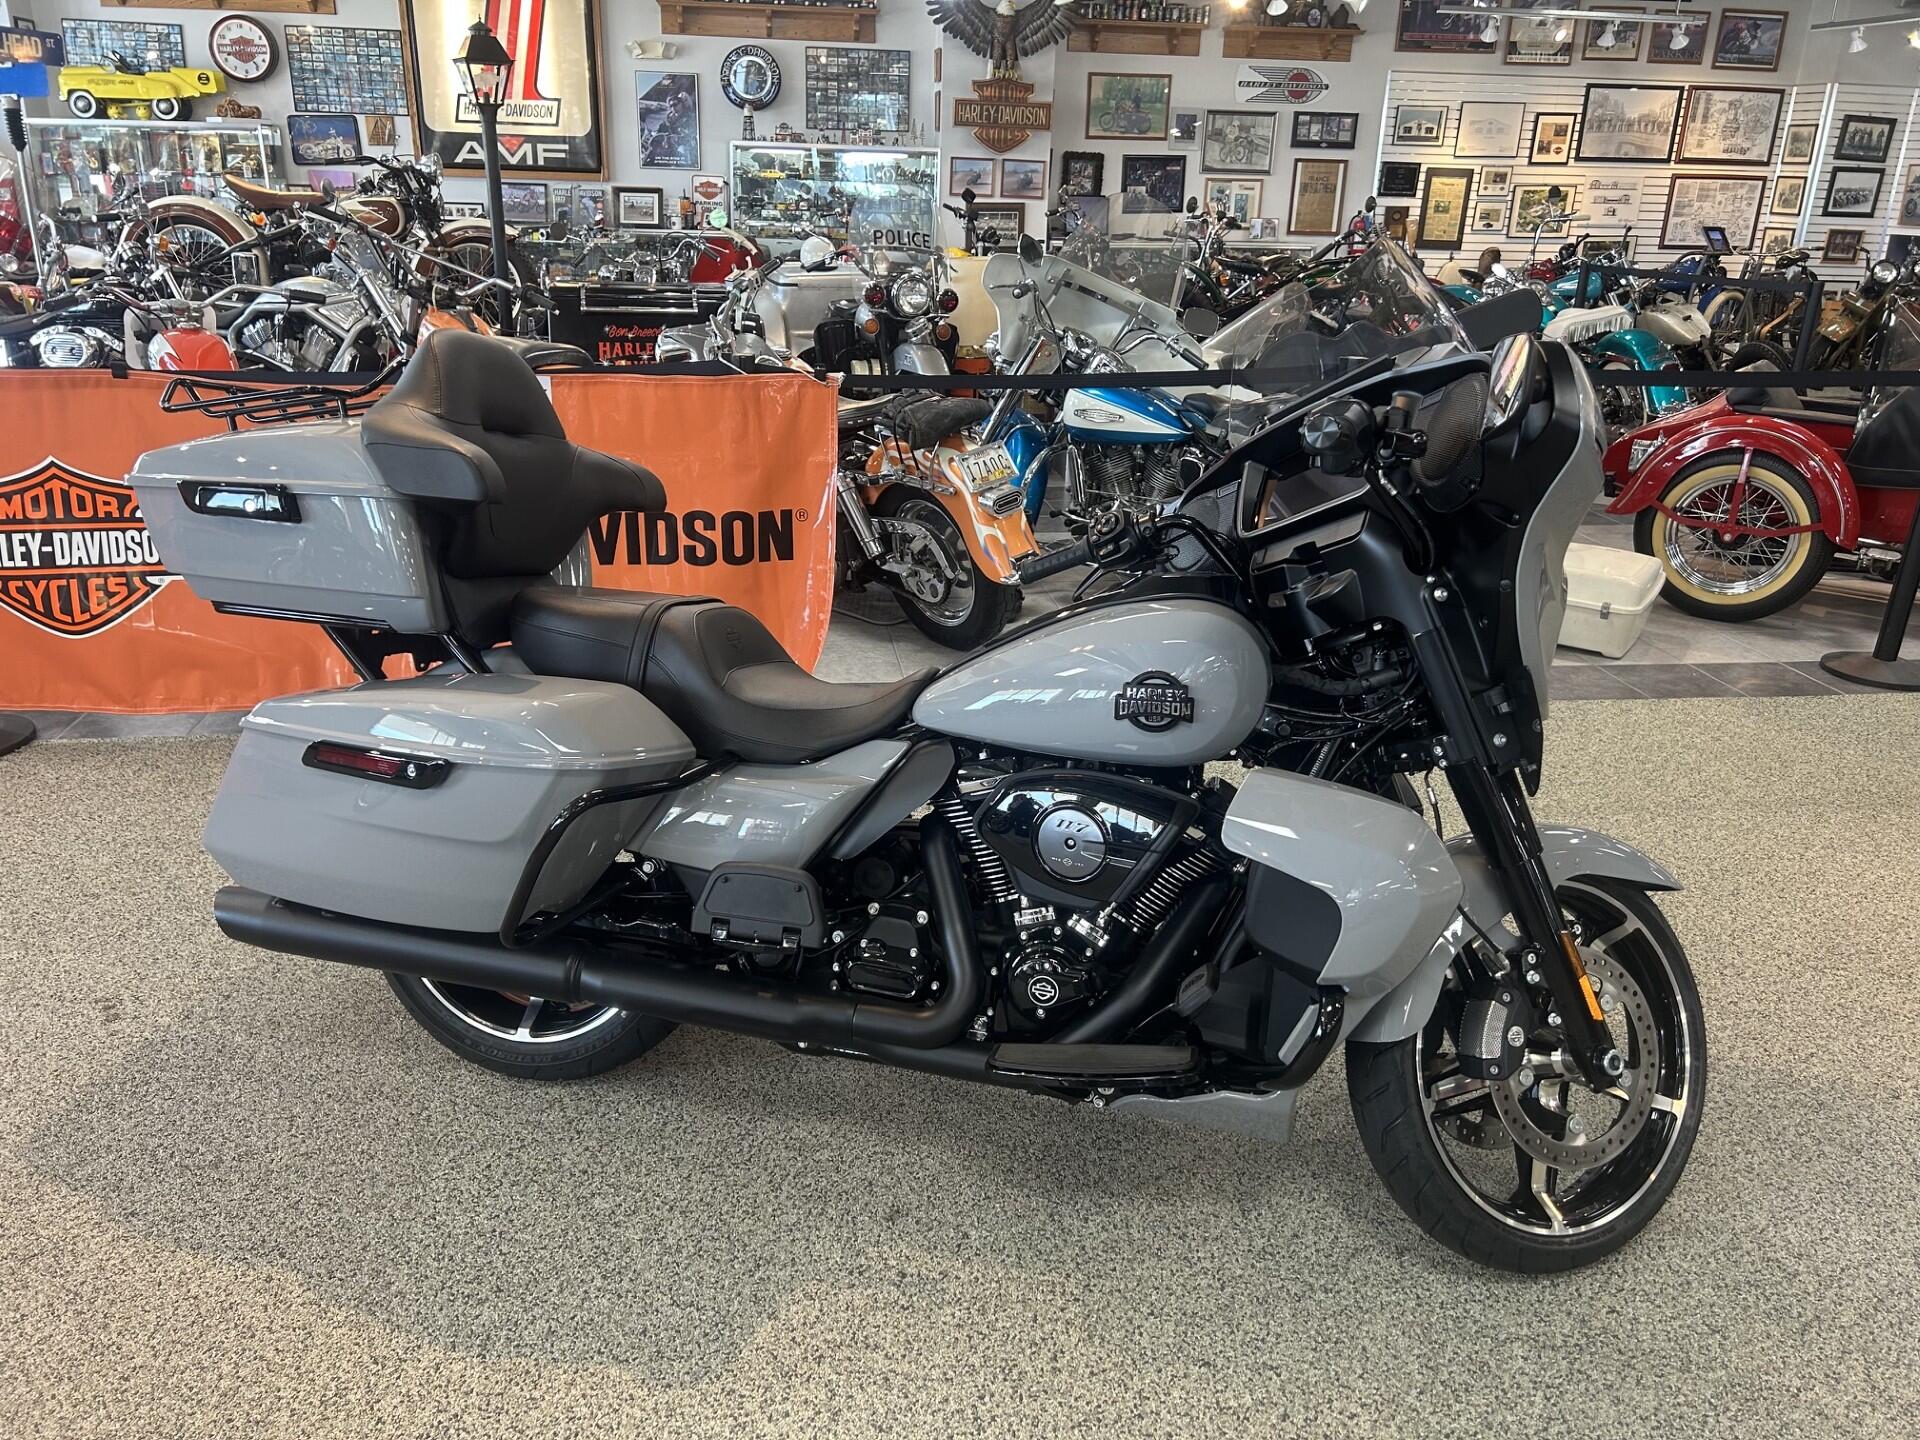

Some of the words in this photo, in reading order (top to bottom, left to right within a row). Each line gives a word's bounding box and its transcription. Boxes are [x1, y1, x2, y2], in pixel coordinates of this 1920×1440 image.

[0, 32, 42, 57] HEAD
[721, 47, 780, 83] HARLEY-DAVIDSON
[982, 84, 1025, 102] MOTOR
[463, 102, 554, 119] HA-DAVIDSON
[959, 103, 1047, 126] HARLEY-DAVIDSON
[454, 140, 569, 166] AMF
[873, 229, 931, 250] POLICE
[598, 341, 654, 360] HARLE
[0, 479, 119, 520] MOTOR
[0, 529, 160, 568] LEY-DAVIDSO
[588, 509, 794, 567] VIDSON
[7, 577, 128, 623] CYCLES
[1119, 698, 1192, 717] DAVIDSON
[1056, 819, 1090, 833] 117
